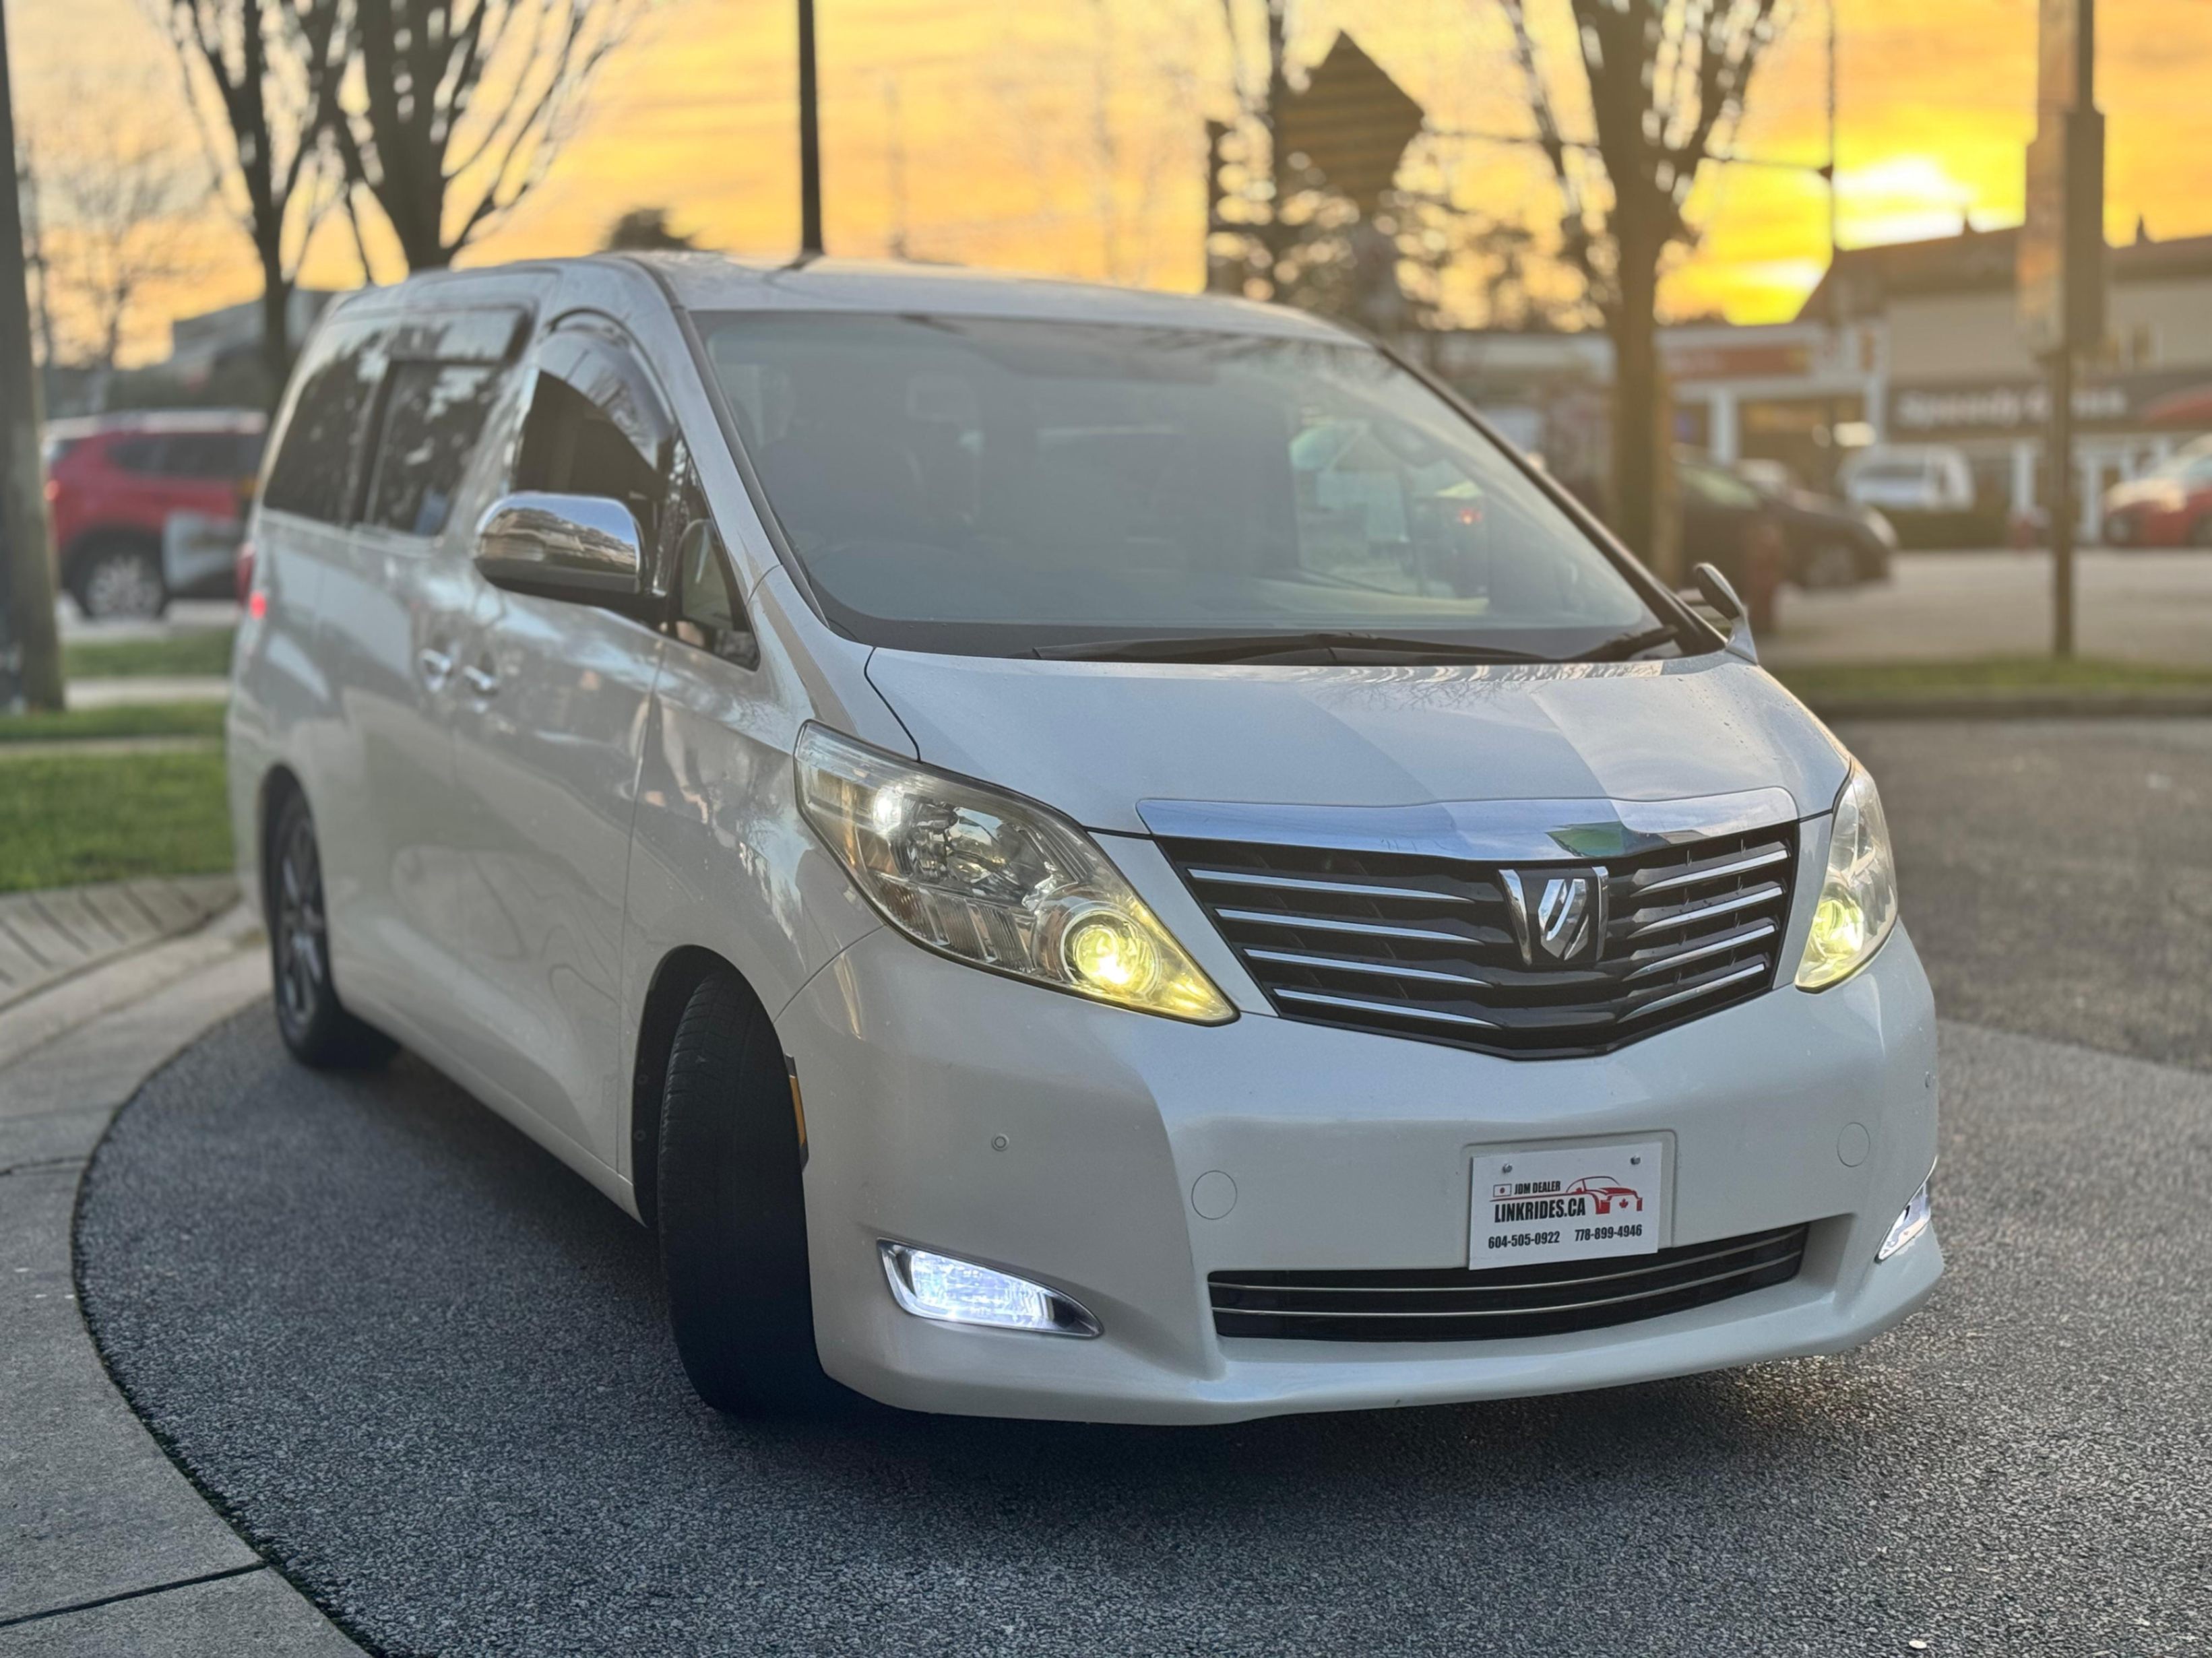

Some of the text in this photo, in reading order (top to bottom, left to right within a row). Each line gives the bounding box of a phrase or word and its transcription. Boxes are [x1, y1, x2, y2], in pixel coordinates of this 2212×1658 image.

[1514, 1180, 1561, 1195] JDM DEALER
[1494, 1197, 1586, 1223] LINKRIDES.CA
[1488, 1223, 1643, 1249] 604-505-0922 778-899-4946
